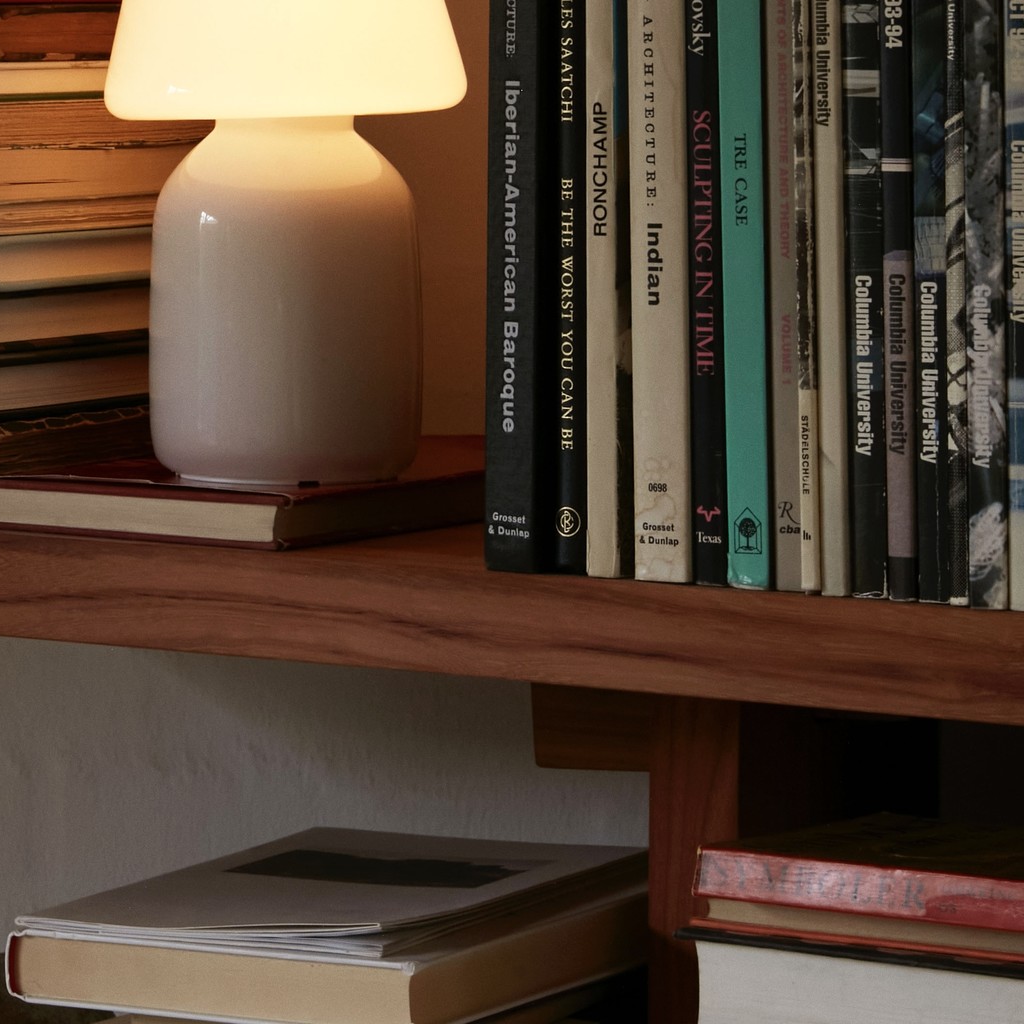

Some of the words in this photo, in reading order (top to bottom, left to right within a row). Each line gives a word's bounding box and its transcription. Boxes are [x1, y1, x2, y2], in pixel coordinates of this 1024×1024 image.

[777, 30, 787, 48] OF
[947, 4, 956, 61] University
[560, 37, 574, 123] SAATCHI
[815, 51, 832, 127] University
[643, 17, 656, 207] ARCHITECTURE:
[593, 102, 608, 236] RONCHAMP
[734, 133, 748, 170] TRE
[503, 80, 521, 313] Iberian-American
[560, 178, 574, 201] BE
[692, 110, 713, 263] SCULPTING
[734, 178, 749, 226] CASE
[779, 169, 790, 198] AND
[561, 207, 574, 248] THE
[780, 204, 791, 259] THEORY
[561, 256, 574, 322] WORST
[647, 223, 664, 306] Indian
[695, 271, 714, 298] IN
[695, 306, 715, 376] TIME
[854, 275, 873, 356] Columbia
[888, 273, 905, 356] Columbia
[920, 281, 937, 363] Columbia
[561, 329, 574, 371] YOU
[781, 314, 792, 374] VOLUME
[500, 321, 519, 433] Baroque
[561, 378, 574, 420] CAN
[856, 361, 874, 457] University
[888, 361, 907, 456] University
[920, 369, 938, 464] University
[561, 428, 574, 451] BE
[648, 482, 668, 494] 0698
[488, 525, 495, 534] &
[498, 526, 530, 538] Dunlap
[492, 512, 526, 524] Grosset
[639, 535, 646, 544] &
[648, 535, 679, 547] Dunlap
[642, 522, 675, 532] Grosset
[696, 531, 722, 544] Texas
[779, 525, 801, 534] cba
